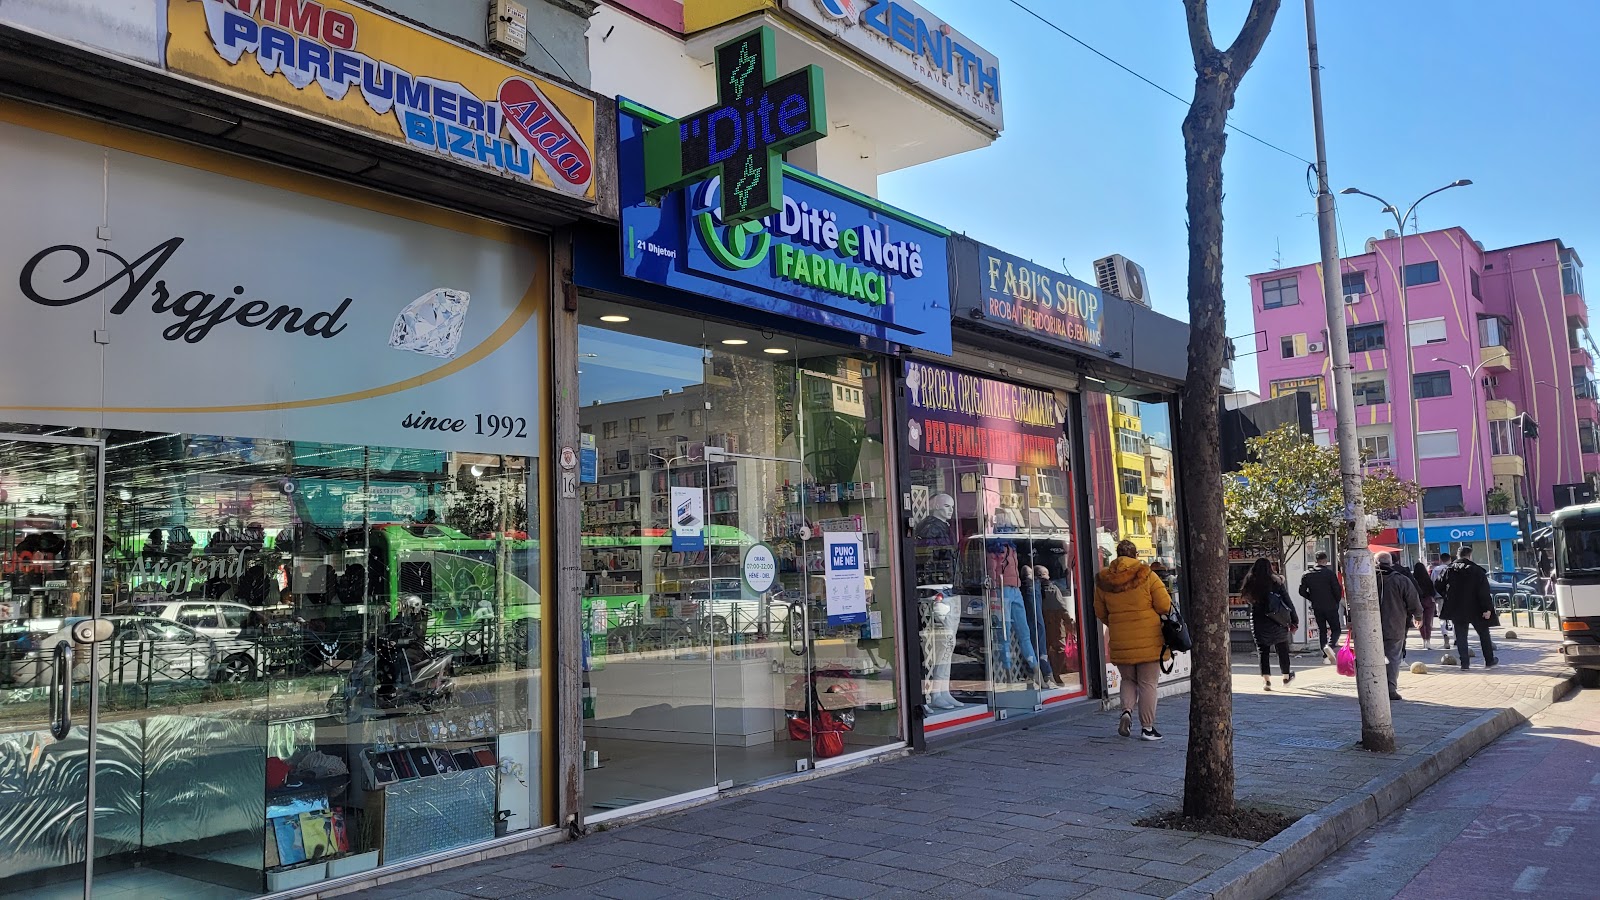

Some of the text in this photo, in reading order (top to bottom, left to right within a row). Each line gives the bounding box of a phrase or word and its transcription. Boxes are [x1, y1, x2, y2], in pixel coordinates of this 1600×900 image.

[224, 11, 496, 134] PARFUMERI
[913, 62, 996, 115] TRAVEL & TOURS
[404, 111, 530, 175] BIZHU
[502, 100, 585, 180] Alda
[637, 239, 676, 258] 21 Dhjetori
[780, 194, 923, 278] Ditë e Natë
[19, 237, 353, 343] Argjend
[778, 243, 886, 305] FARMACI
[988, 256, 1098, 323] FABI'S SHOP
[989, 297, 1017, 321] RROBA
[1018, 306, 1027, 324] TE
[1067, 322, 1101, 347] GJERMANE
[920, 365, 1056, 428] RROBA ORIGJINALE GJERMANE
[401, 411, 528, 438] since 1992
[925, 419, 948, 454] PER
[948, 423, 988, 458] FEMIJE
[563, 477, 575, 493] 16
[834, 546, 854, 556] PUNO
[1450, 528, 1475, 539] One
[127, 545, 252, 596] Argjend
[833, 556, 856, 566] ME NE!
